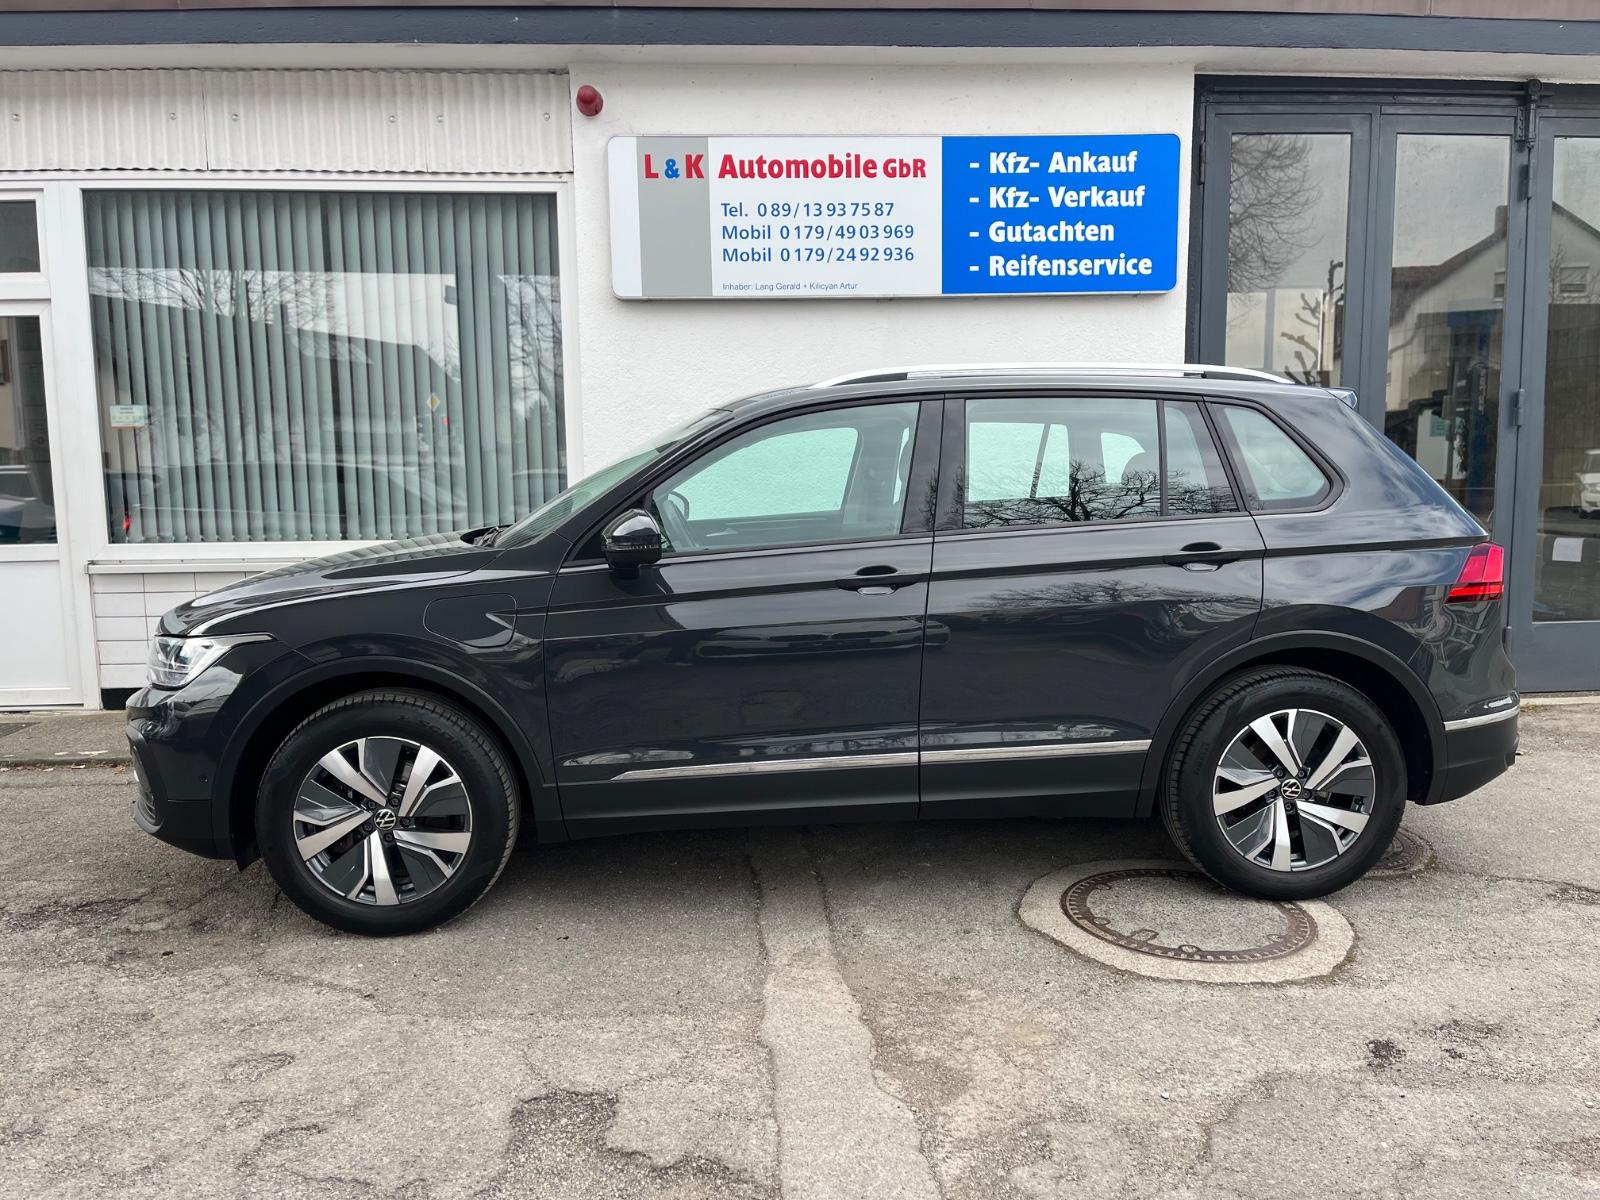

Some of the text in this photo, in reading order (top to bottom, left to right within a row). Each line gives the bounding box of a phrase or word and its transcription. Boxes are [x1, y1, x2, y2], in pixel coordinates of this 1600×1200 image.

[644, 152, 927, 181] L & K Automobile GbR
[988, 151, 1041, 175] Kfz-
[1047, 150, 1139, 174] Ankauf
[988, 186, 1041, 209] Kfz-
[1047, 185, 1147, 208] Verkauf
[720, 202, 749, 217] Tel.
[721, 224, 772, 240] Mobil
[988, 220, 1116, 243] Gutachten
[722, 246, 773, 263] Mobil
[989, 252, 1153, 277] Reifenservice
[755, 282, 774, 292] Lang
[775, 282, 801, 291] Gerald
[839, 281, 858, 290] Artur
